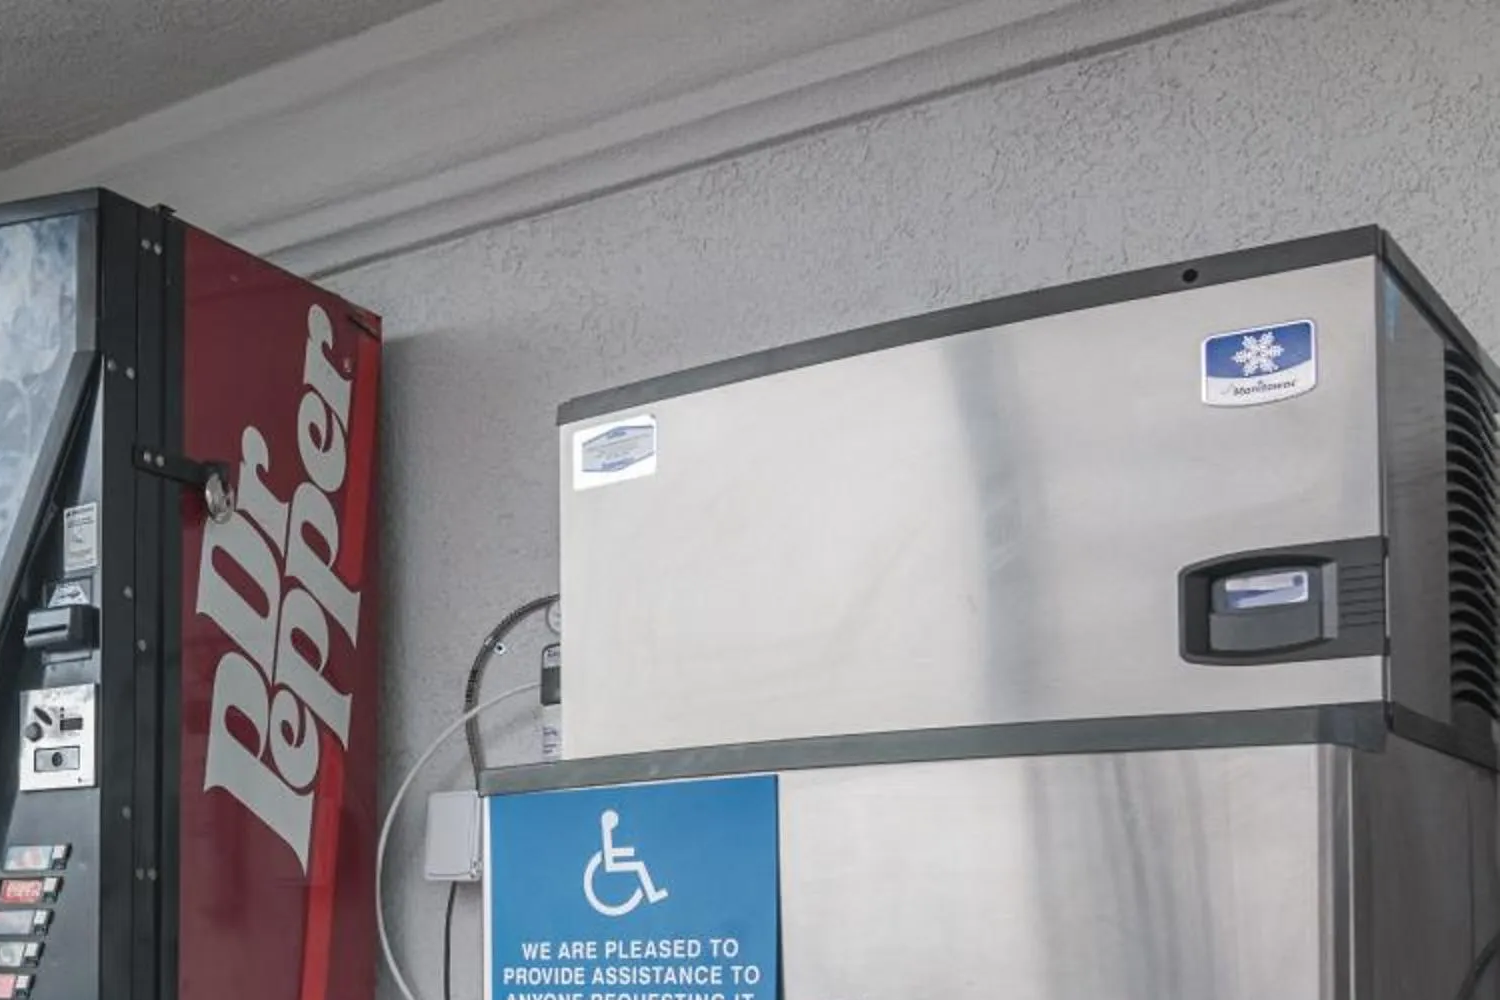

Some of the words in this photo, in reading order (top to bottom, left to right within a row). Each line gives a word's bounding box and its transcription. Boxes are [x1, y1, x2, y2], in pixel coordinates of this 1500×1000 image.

[196, 425, 289, 686] Dr
[203, 304, 361, 877] Pepper
[503, 967, 585, 985] PROVIDE
[591, 966, 723, 985] ASSISTANCE
[730, 965, 760, 985] TO
[522, 943, 550, 960] WE
[558, 942, 597, 959] ARE
[605, 939, 701, 959] PLEASED
[710, 938, 739, 958] TO
